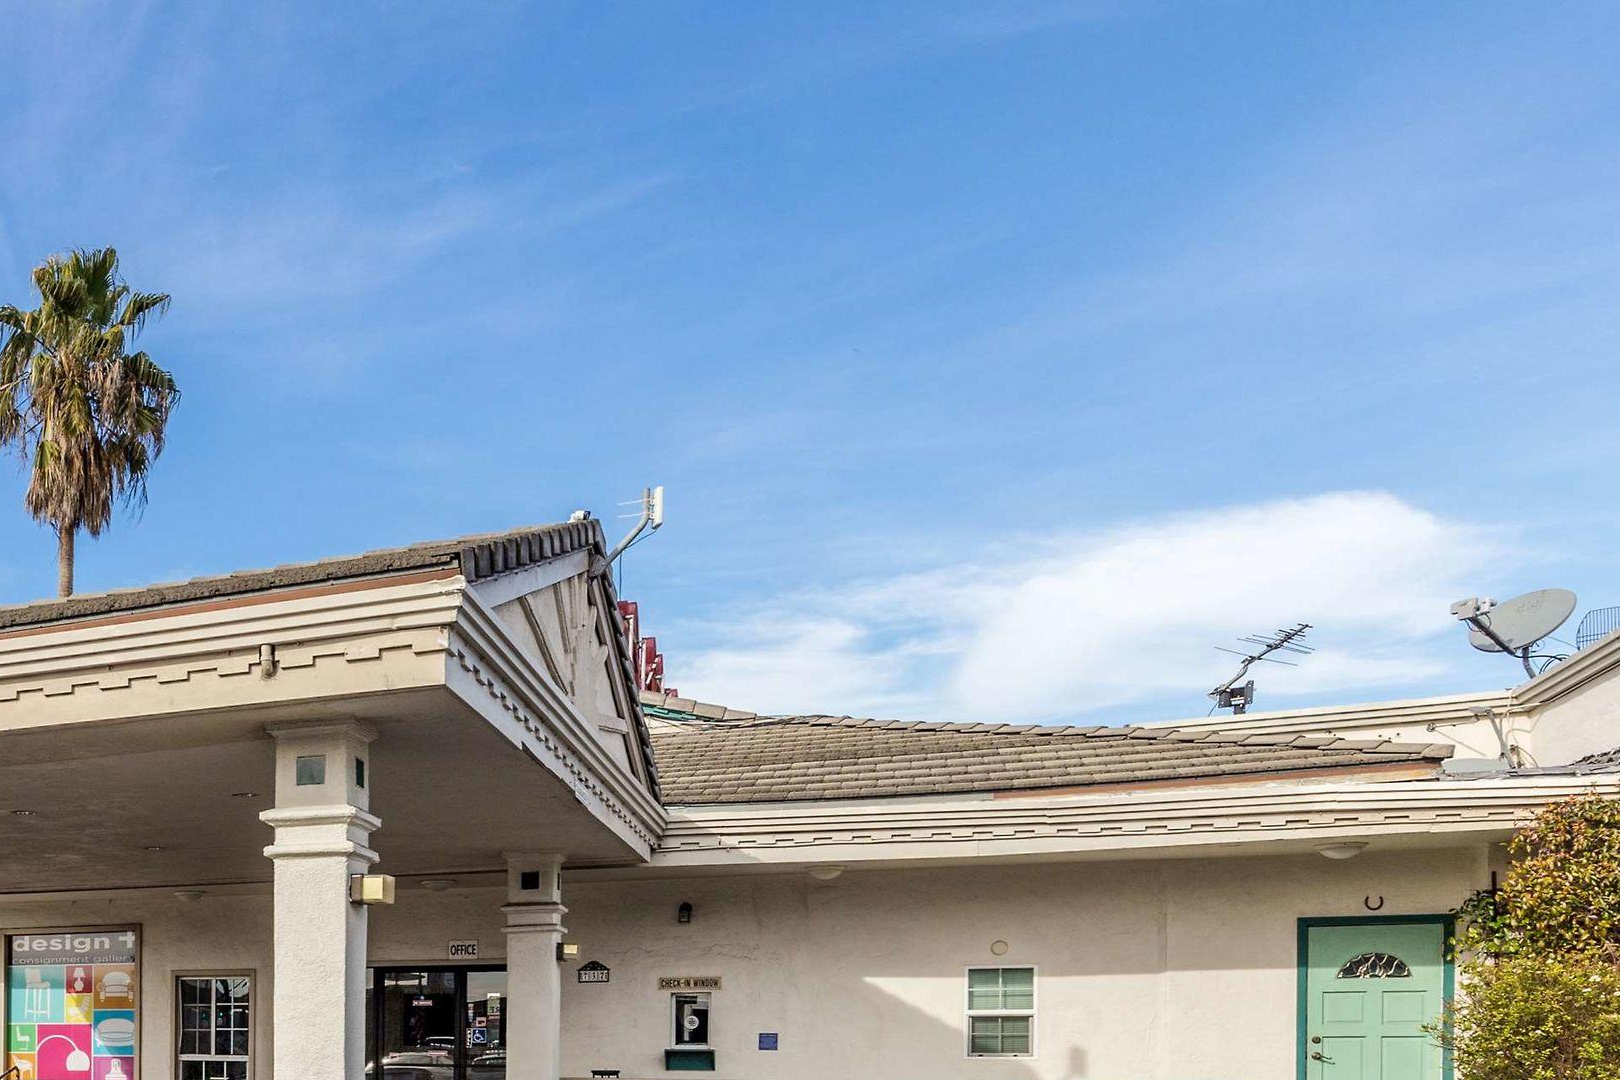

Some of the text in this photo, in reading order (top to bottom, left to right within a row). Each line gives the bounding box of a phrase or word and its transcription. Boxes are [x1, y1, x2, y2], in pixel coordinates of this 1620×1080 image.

[12, 935, 110, 953] design
[450, 944, 477, 956] OFFICE
[12, 956, 89, 965] consignment
